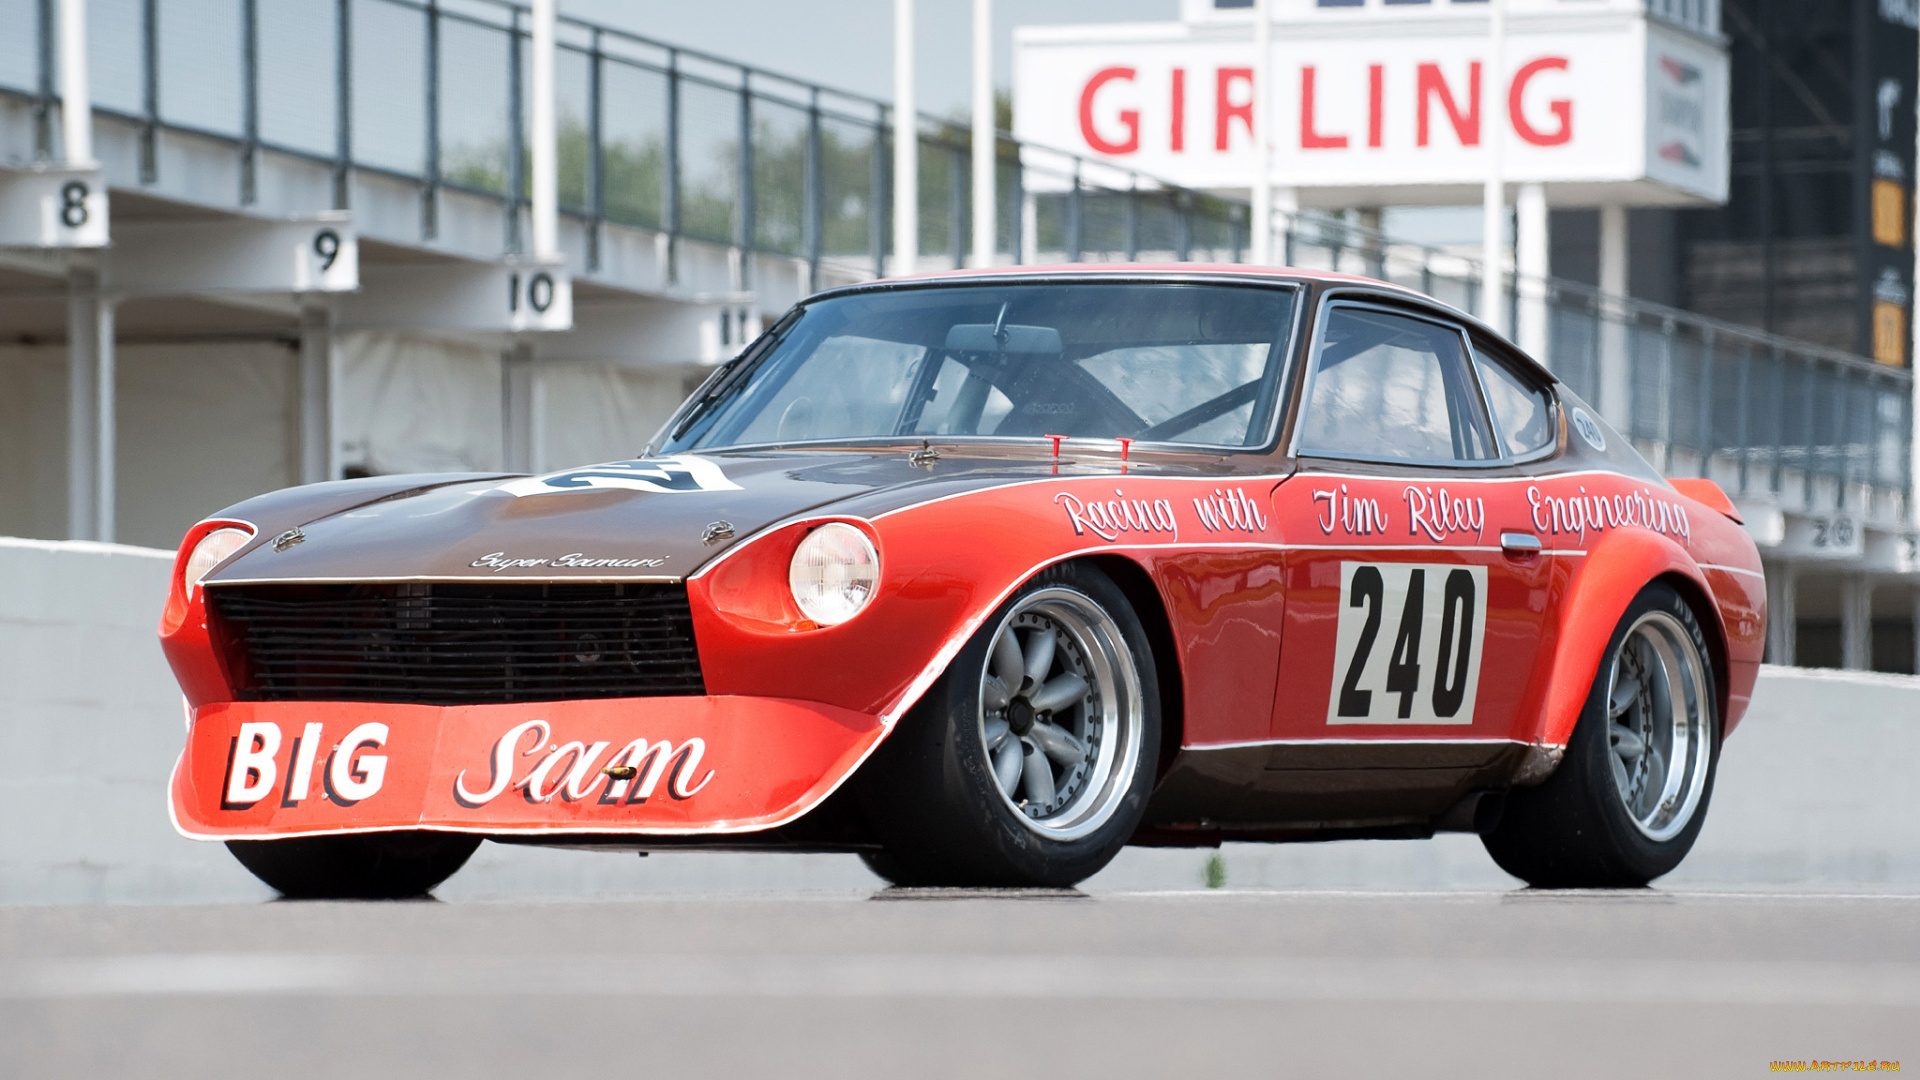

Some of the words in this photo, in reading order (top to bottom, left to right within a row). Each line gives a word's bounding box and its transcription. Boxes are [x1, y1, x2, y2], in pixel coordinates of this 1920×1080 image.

[1079, 57, 1574, 155] GIRLING
[60, 180, 88, 229] 8
[313, 228, 342, 272] 9
[508, 270, 555, 315] 10
[1576, 417, 1602, 442] 240
[1054, 488, 1178, 543] Racing
[1193, 487, 1267, 533] with
[1313, 484, 1388, 536] Tim
[1402, 485, 1486, 544] Riley
[1527, 485, 1691, 548] Engineering
[470, 551, 549, 573] Super
[550, 552, 671, 568] Samuri
[1337, 565, 1476, 719] 240
[221, 721, 390, 810] BIG
[453, 719, 716, 809] Sam
